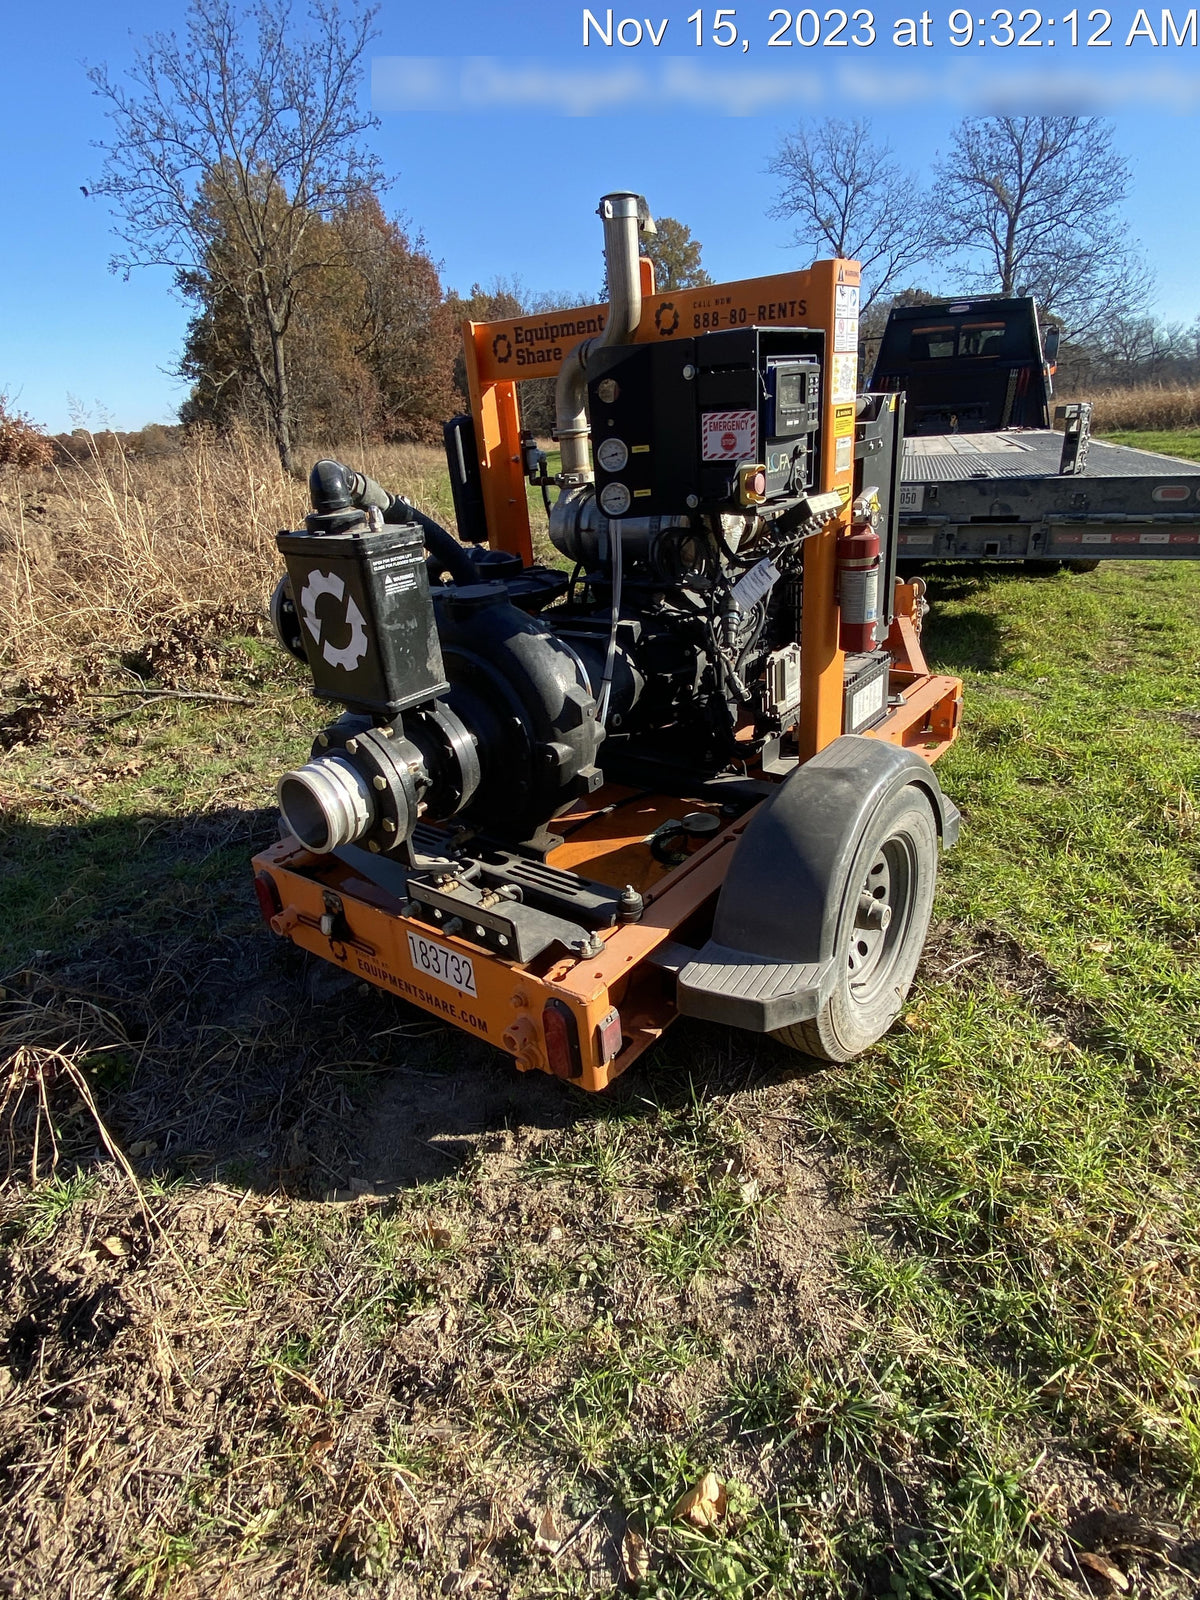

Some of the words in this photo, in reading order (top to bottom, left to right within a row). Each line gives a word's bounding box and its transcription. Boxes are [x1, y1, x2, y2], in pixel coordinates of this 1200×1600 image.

[693, 299, 711, 309] CALL
[693, 300, 808, 330] 888-80-RENTS
[513, 314, 605, 345] Equipment
[516, 347, 563, 366] Share
[708, 420, 749, 432] EMERGENCY
[767, 453, 790, 473] LOFA
[408, 935, 475, 991] 183732
[357, 958, 488, 1033] EQUIPMENTSHARE.COM
